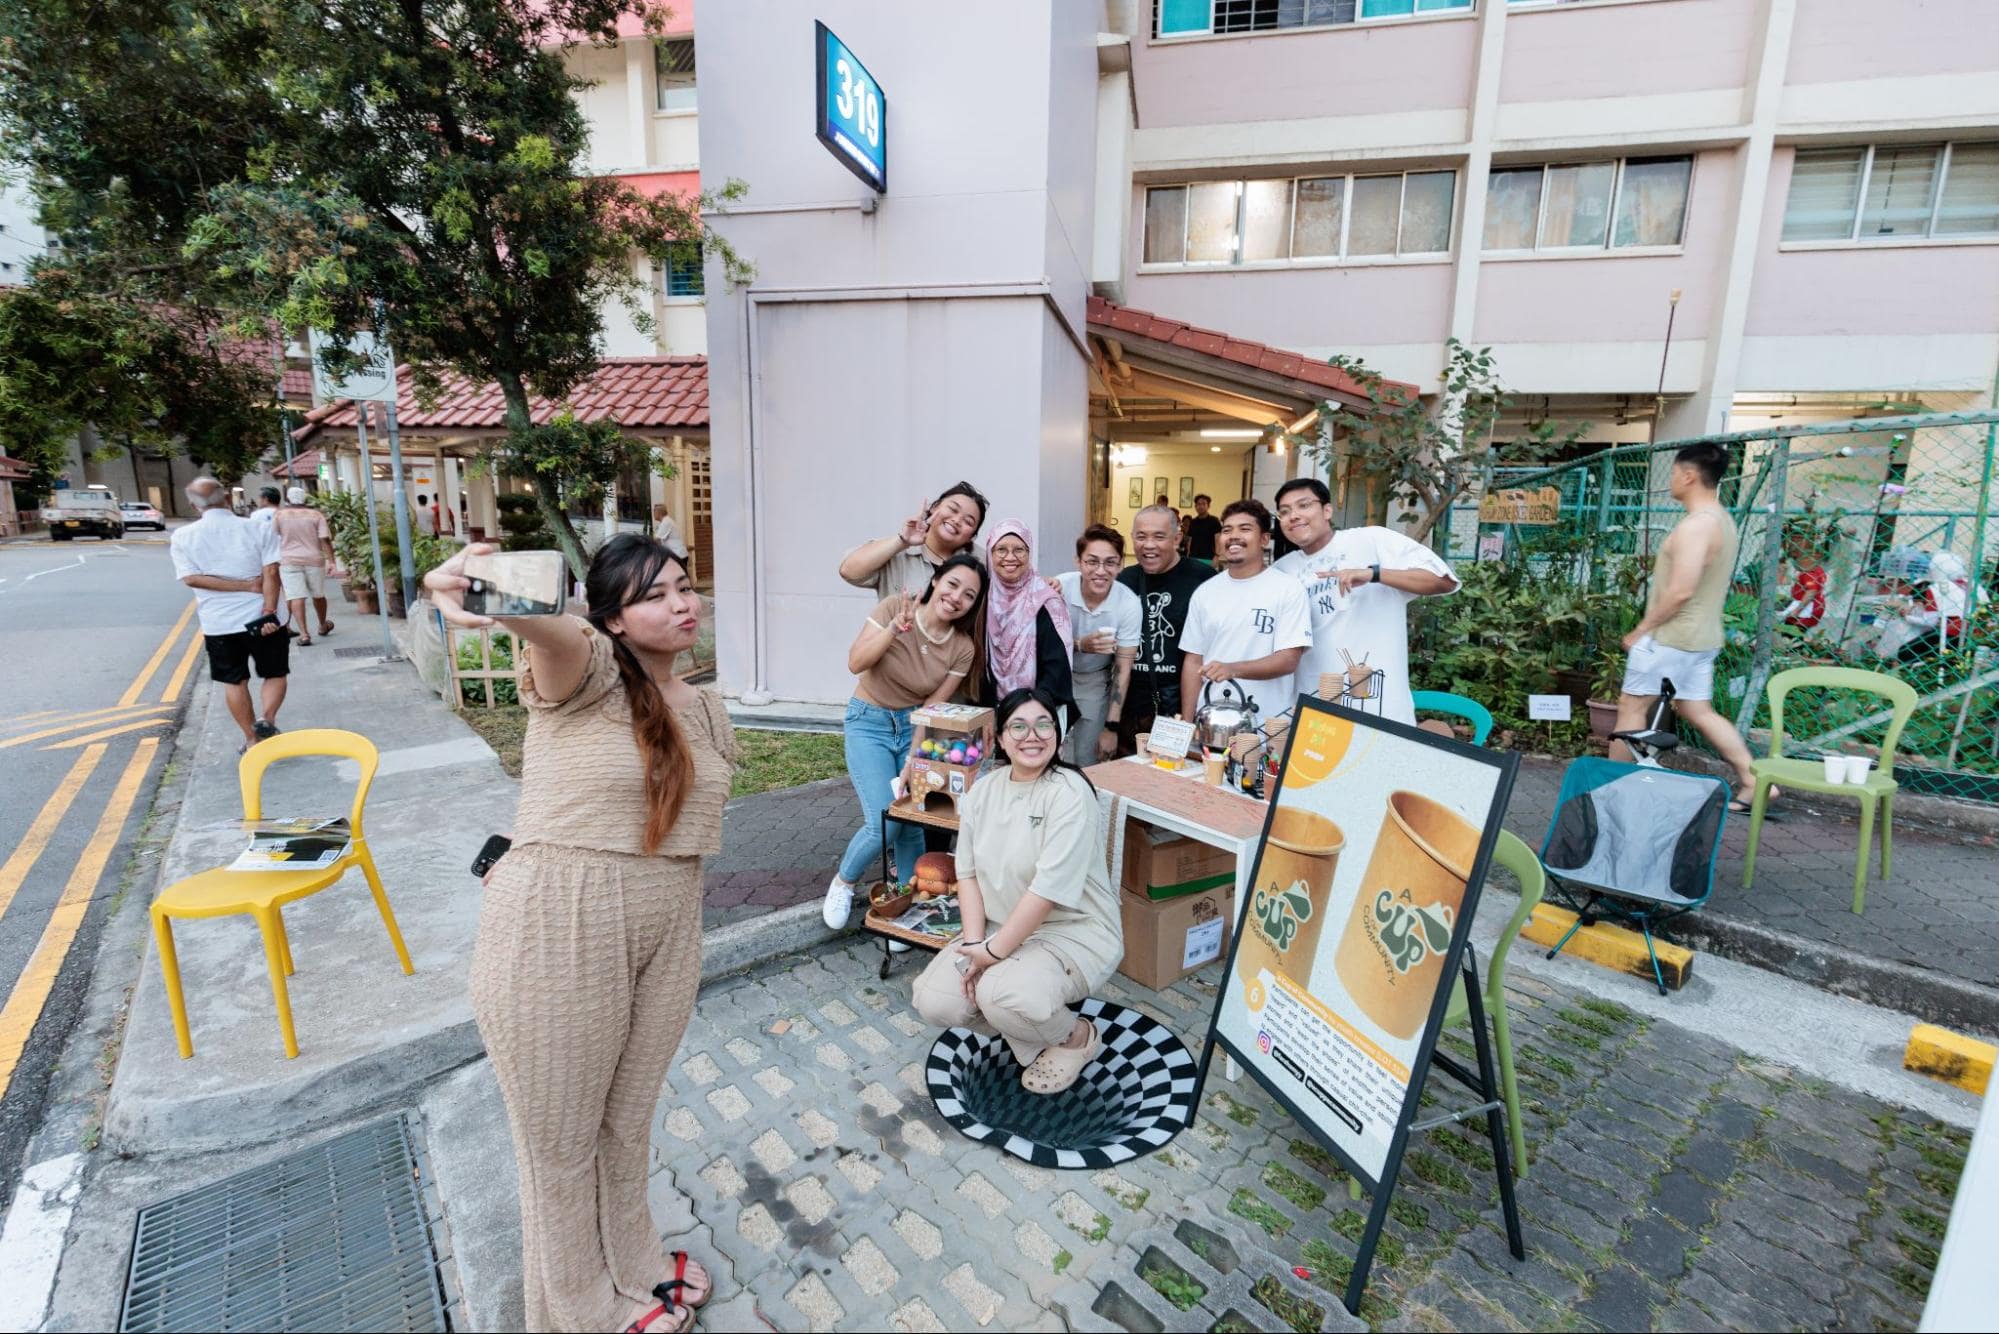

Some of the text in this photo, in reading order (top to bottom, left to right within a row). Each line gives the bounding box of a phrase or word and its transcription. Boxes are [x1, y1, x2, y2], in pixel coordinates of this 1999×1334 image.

[836, 59, 879, 148] 319
[1251, 608, 1275, 635] TB
[1269, 881, 1280, 893] A
[1399, 888, 1412, 903] A
[1255, 889, 1297, 952] CUP
[1375, 889, 1426, 974] CUP
[1362, 904, 1396, 986] COMMUNITY
[1251, 987, 1259, 1002] 6
